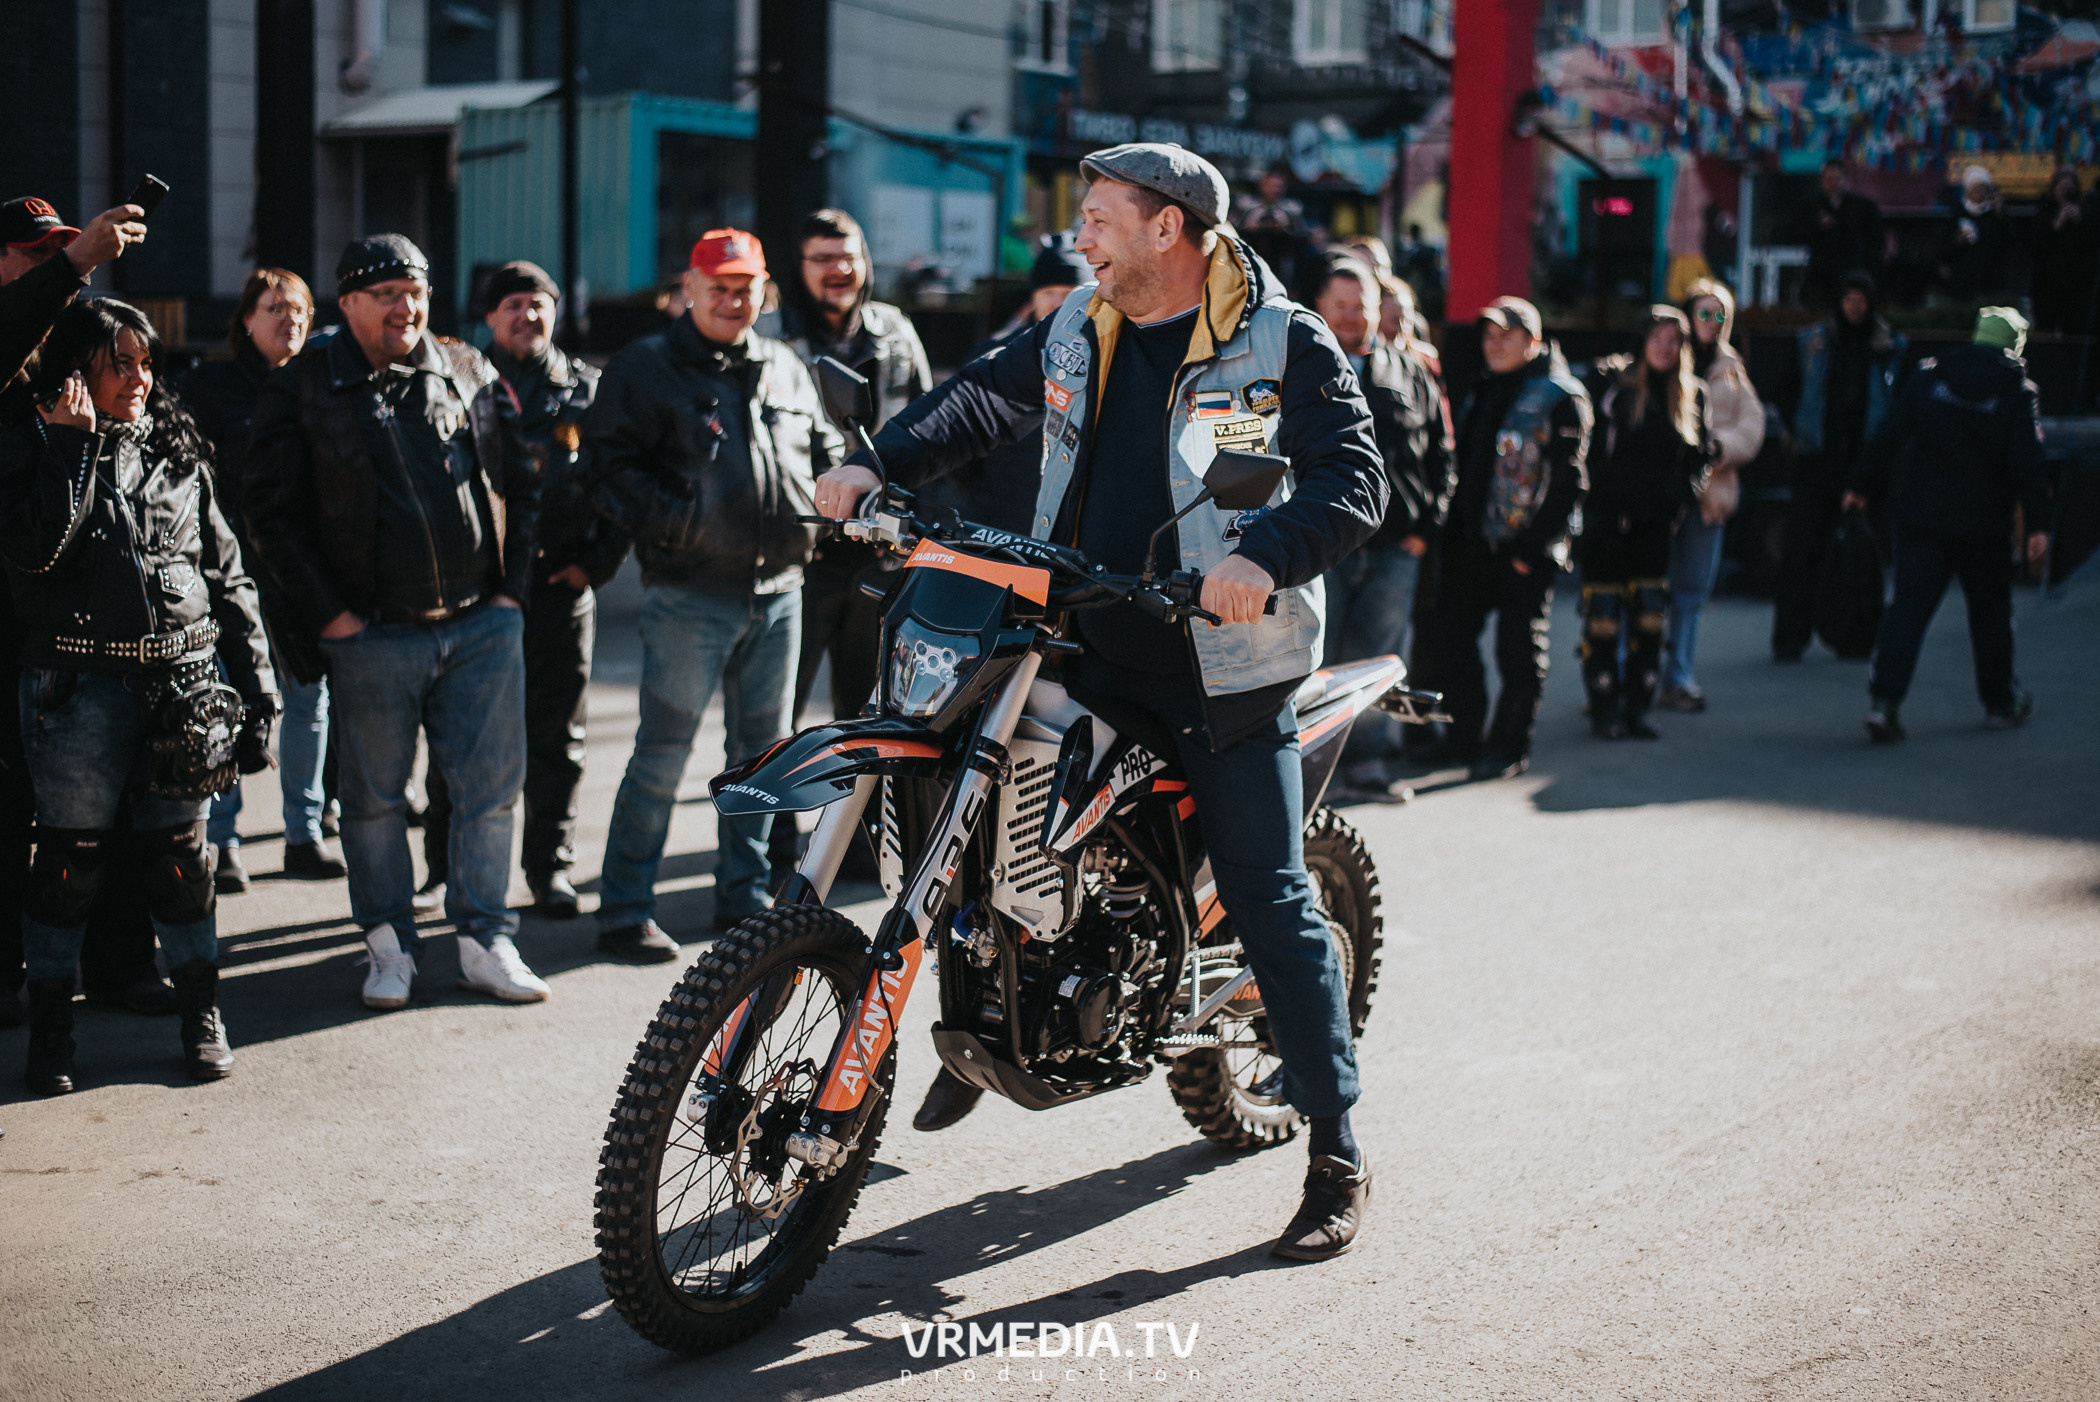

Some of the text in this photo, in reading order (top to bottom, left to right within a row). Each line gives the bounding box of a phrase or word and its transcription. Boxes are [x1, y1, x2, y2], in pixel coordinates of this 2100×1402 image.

[1214, 419, 1262, 436] V.PRES
[911, 552, 955, 564] AVANTIS
[1121, 747, 1152, 786] PRO
[719, 783, 780, 805] AVANTIS
[1071, 787, 1111, 843] AVANTIS
